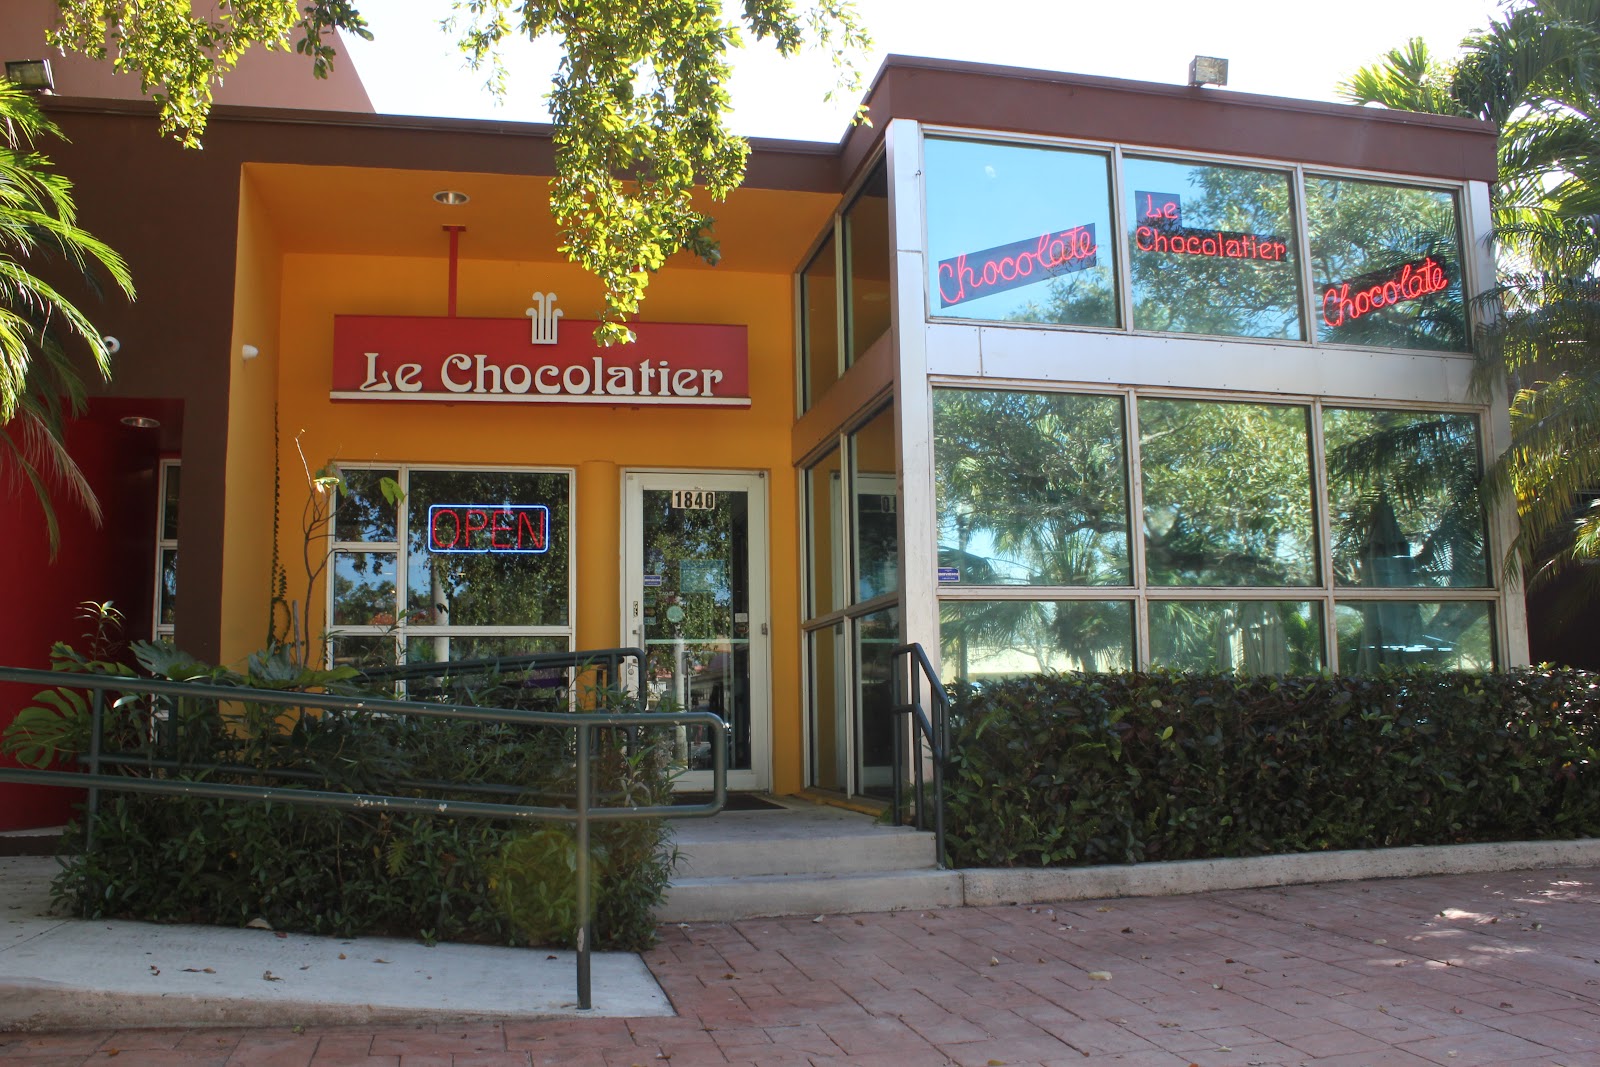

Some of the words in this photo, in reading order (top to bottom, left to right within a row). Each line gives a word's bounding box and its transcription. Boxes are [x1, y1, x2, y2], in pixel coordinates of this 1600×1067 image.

[1145, 193, 1179, 219] Le
[1135, 226, 1286, 261] Chocolatier
[938, 225, 1099, 304] Chocolate
[1322, 257, 1448, 327] Chocolate
[359, 352, 423, 393] Le
[440, 352, 724, 397] Chocolatier
[675, 490, 714, 509] 1840
[432, 509, 545, 549] OPEN
